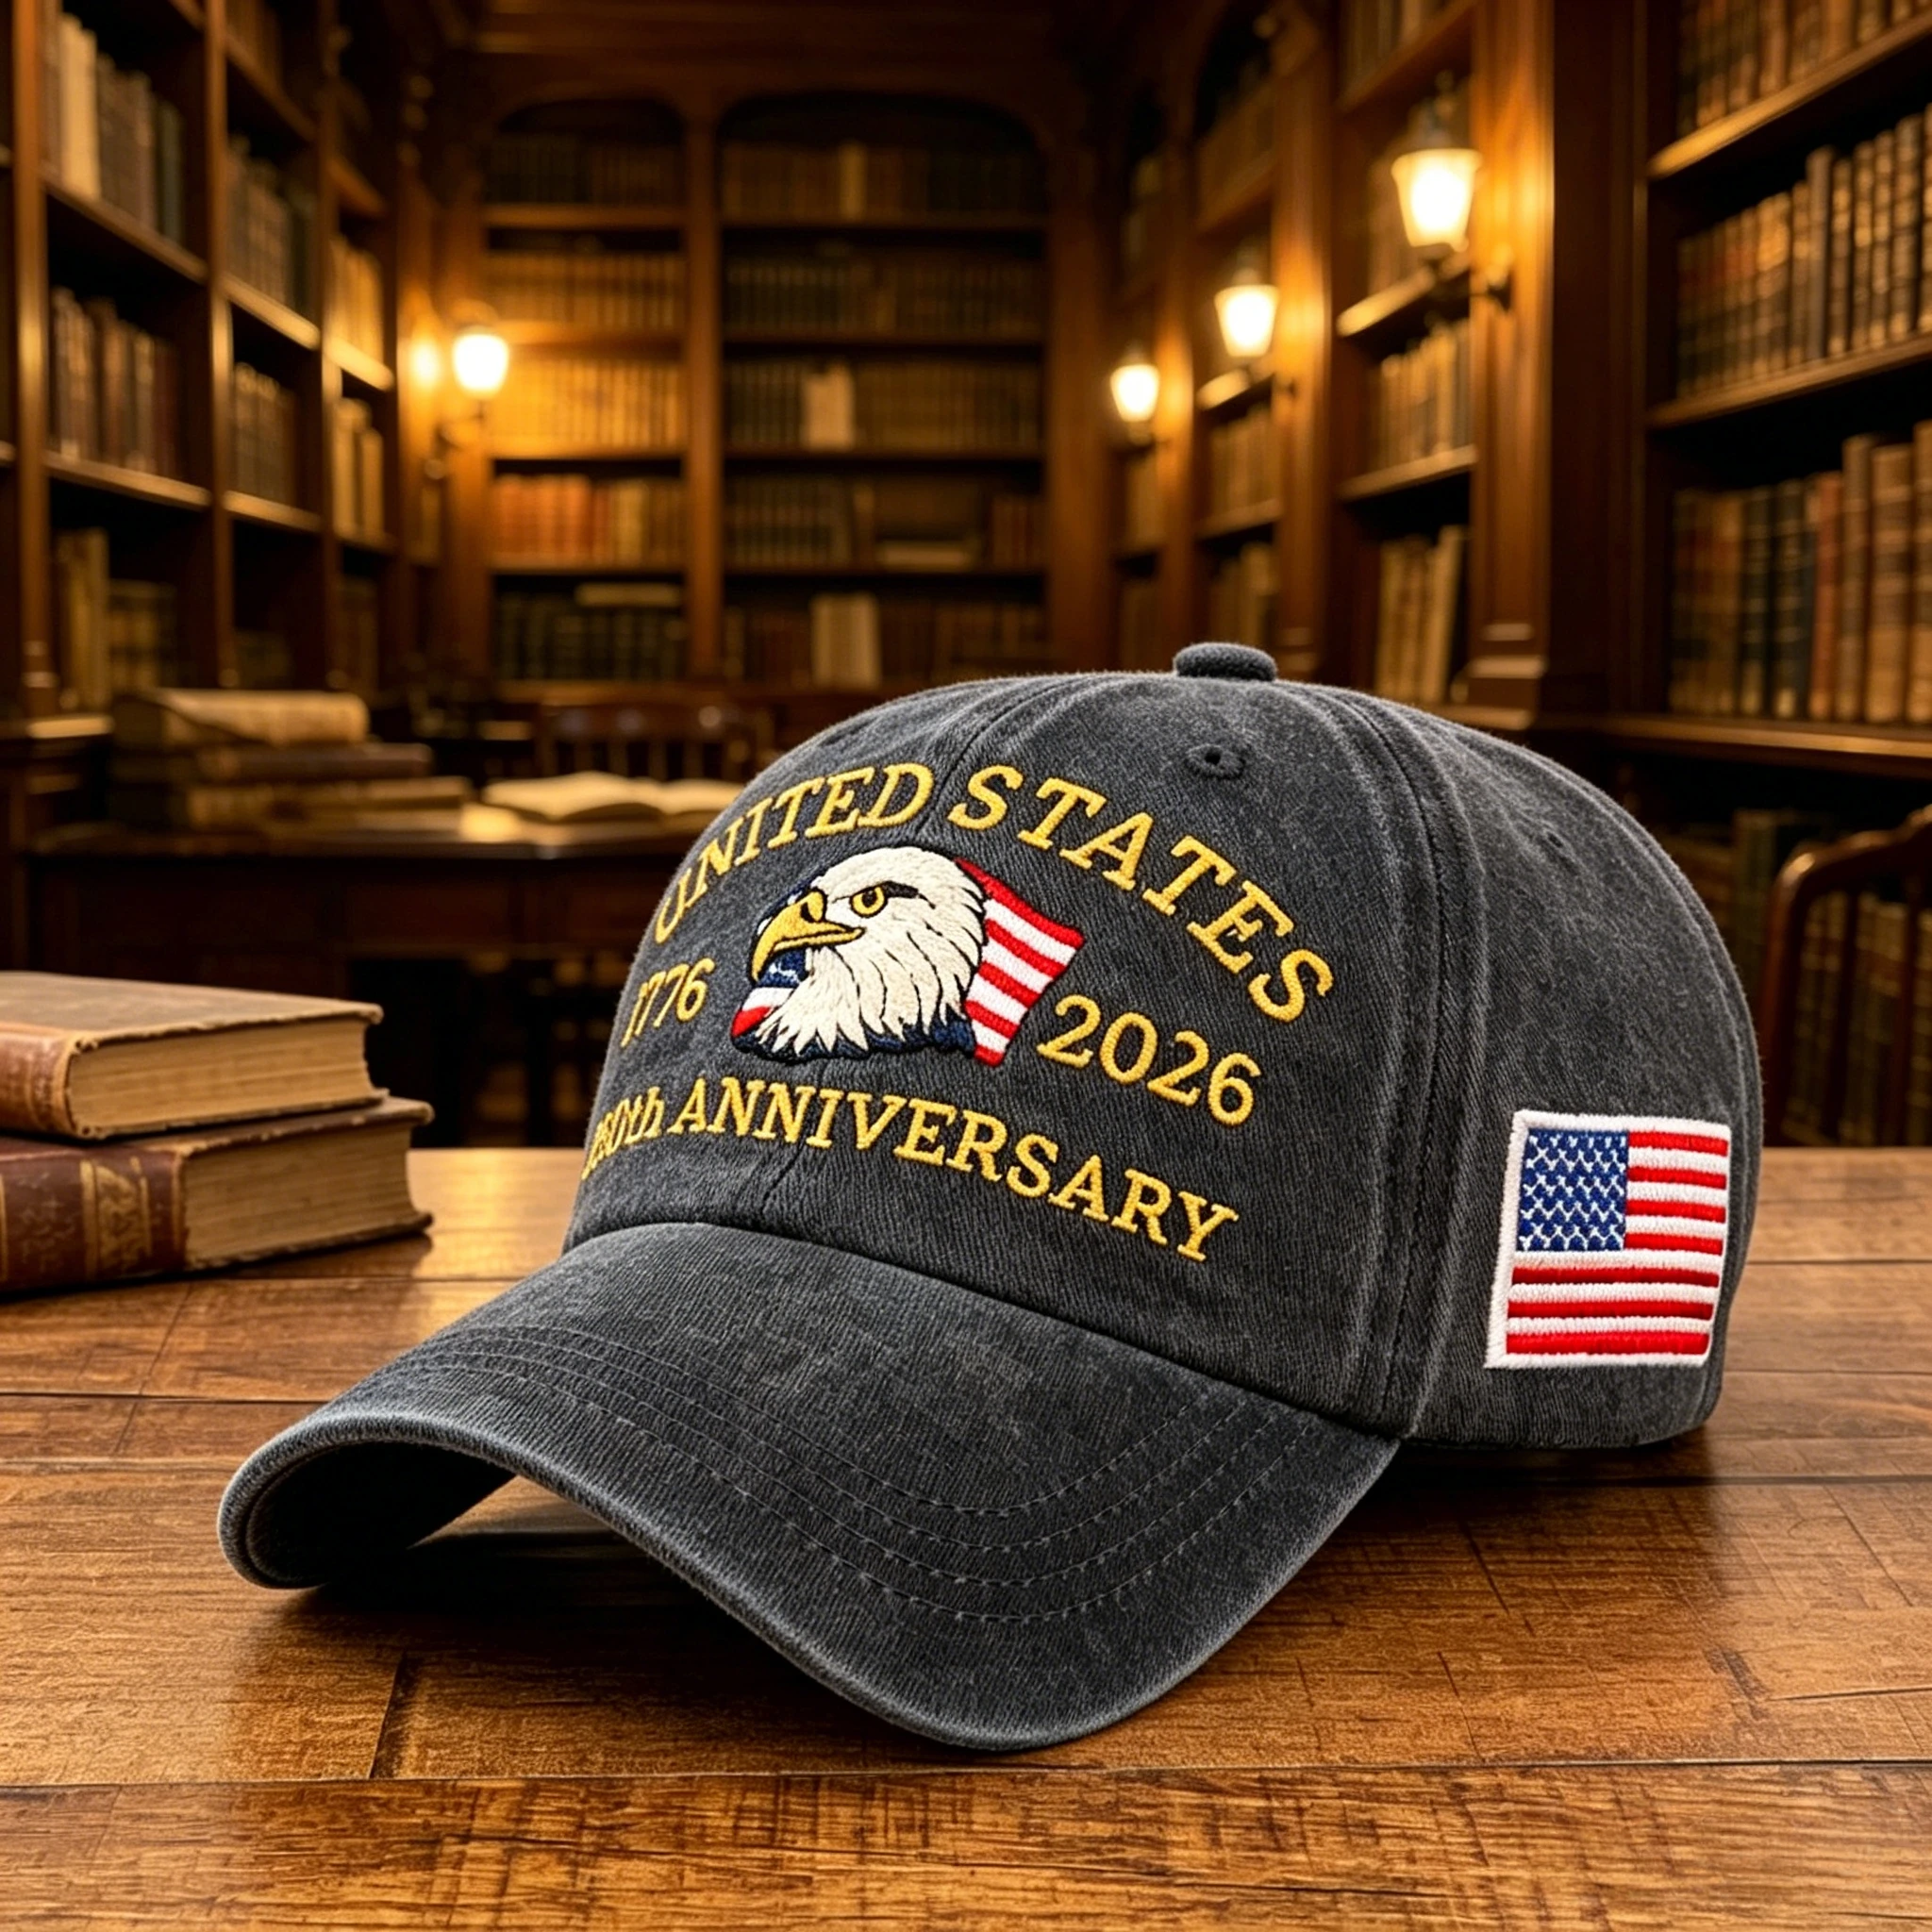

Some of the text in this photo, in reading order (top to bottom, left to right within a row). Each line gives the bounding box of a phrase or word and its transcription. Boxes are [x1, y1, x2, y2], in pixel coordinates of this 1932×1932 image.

[654, 761, 1334, 1023] UNITED STATES
[621, 957, 716, 1048] 1776
[1036, 993, 1261, 1126] 2026
[666, 1076, 1239, 1262] ANNIVERSARY
